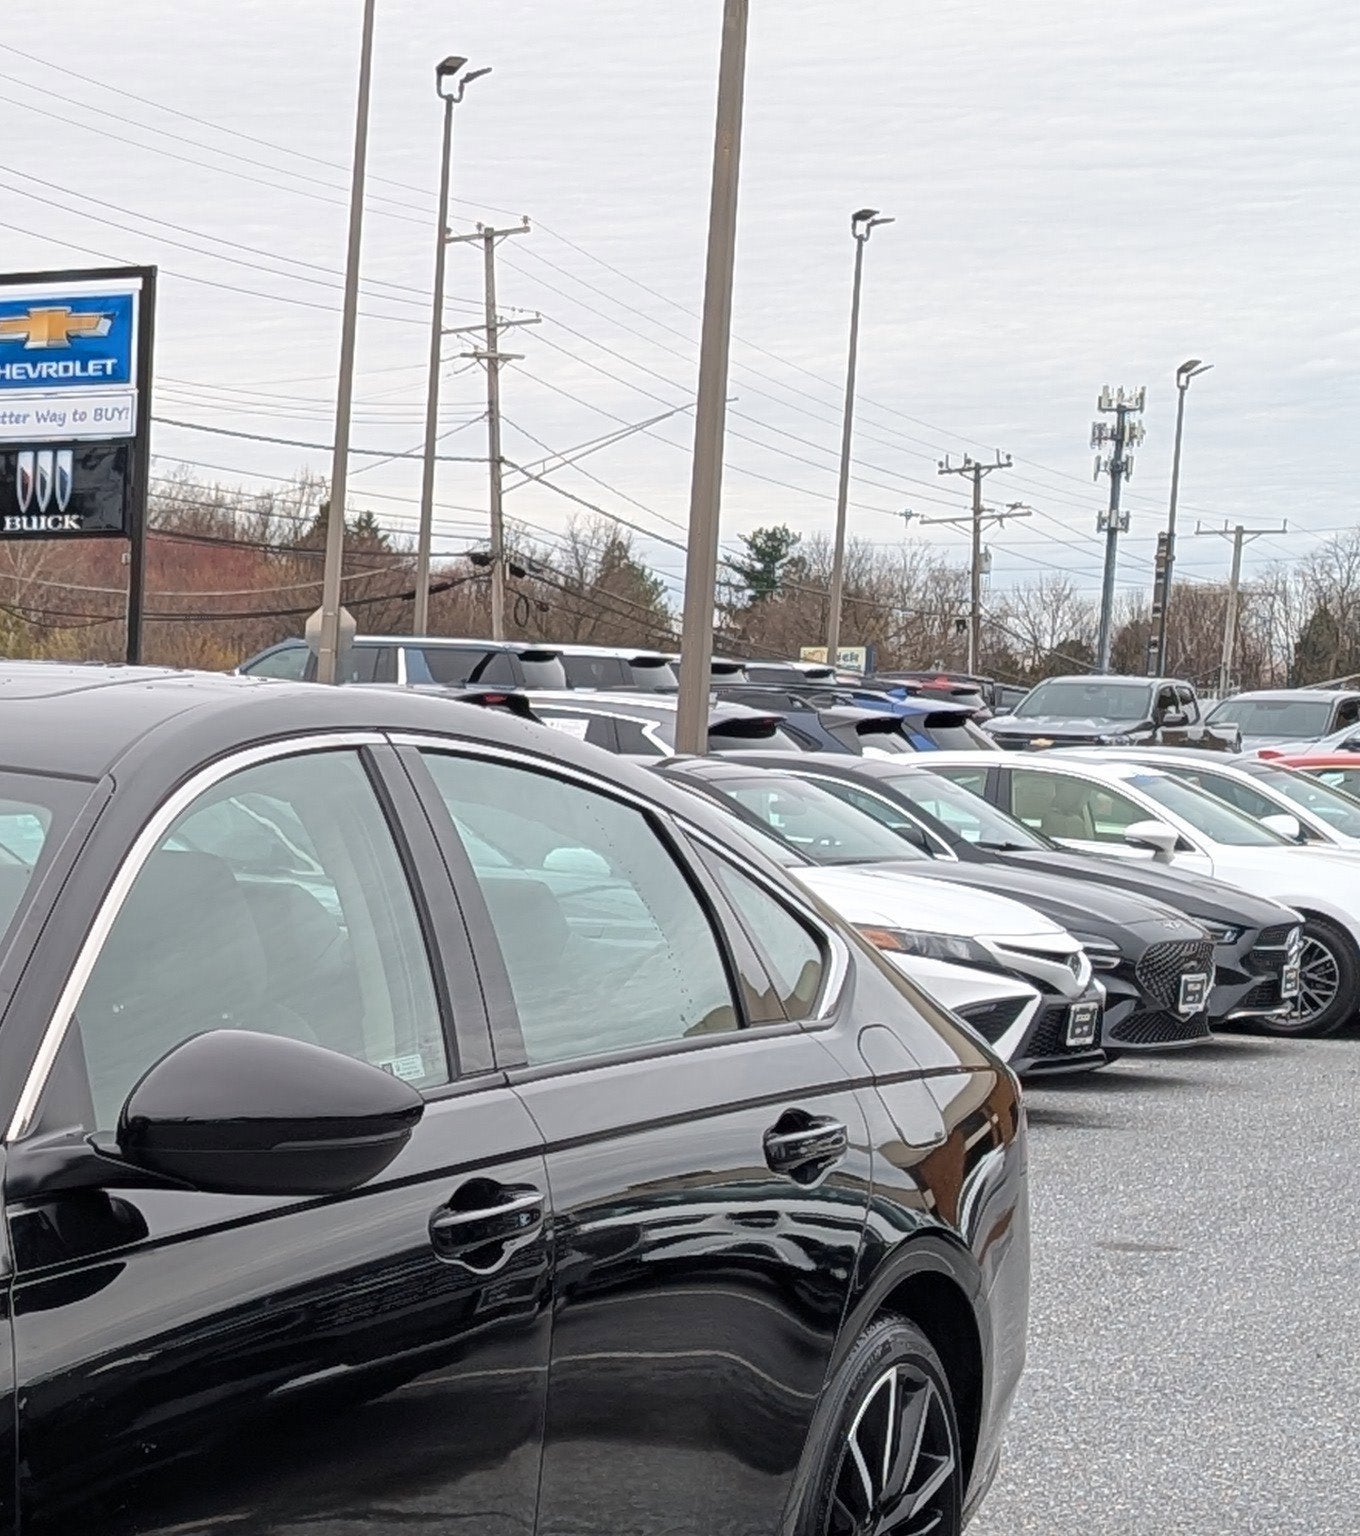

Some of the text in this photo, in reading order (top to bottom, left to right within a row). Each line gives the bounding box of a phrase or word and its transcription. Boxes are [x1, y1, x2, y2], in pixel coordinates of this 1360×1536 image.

[35, 409, 67, 427] Way
[72, 409, 87, 422] to
[93, 406, 130, 422] BUY!
[3, 514, 81, 531] BUICK
